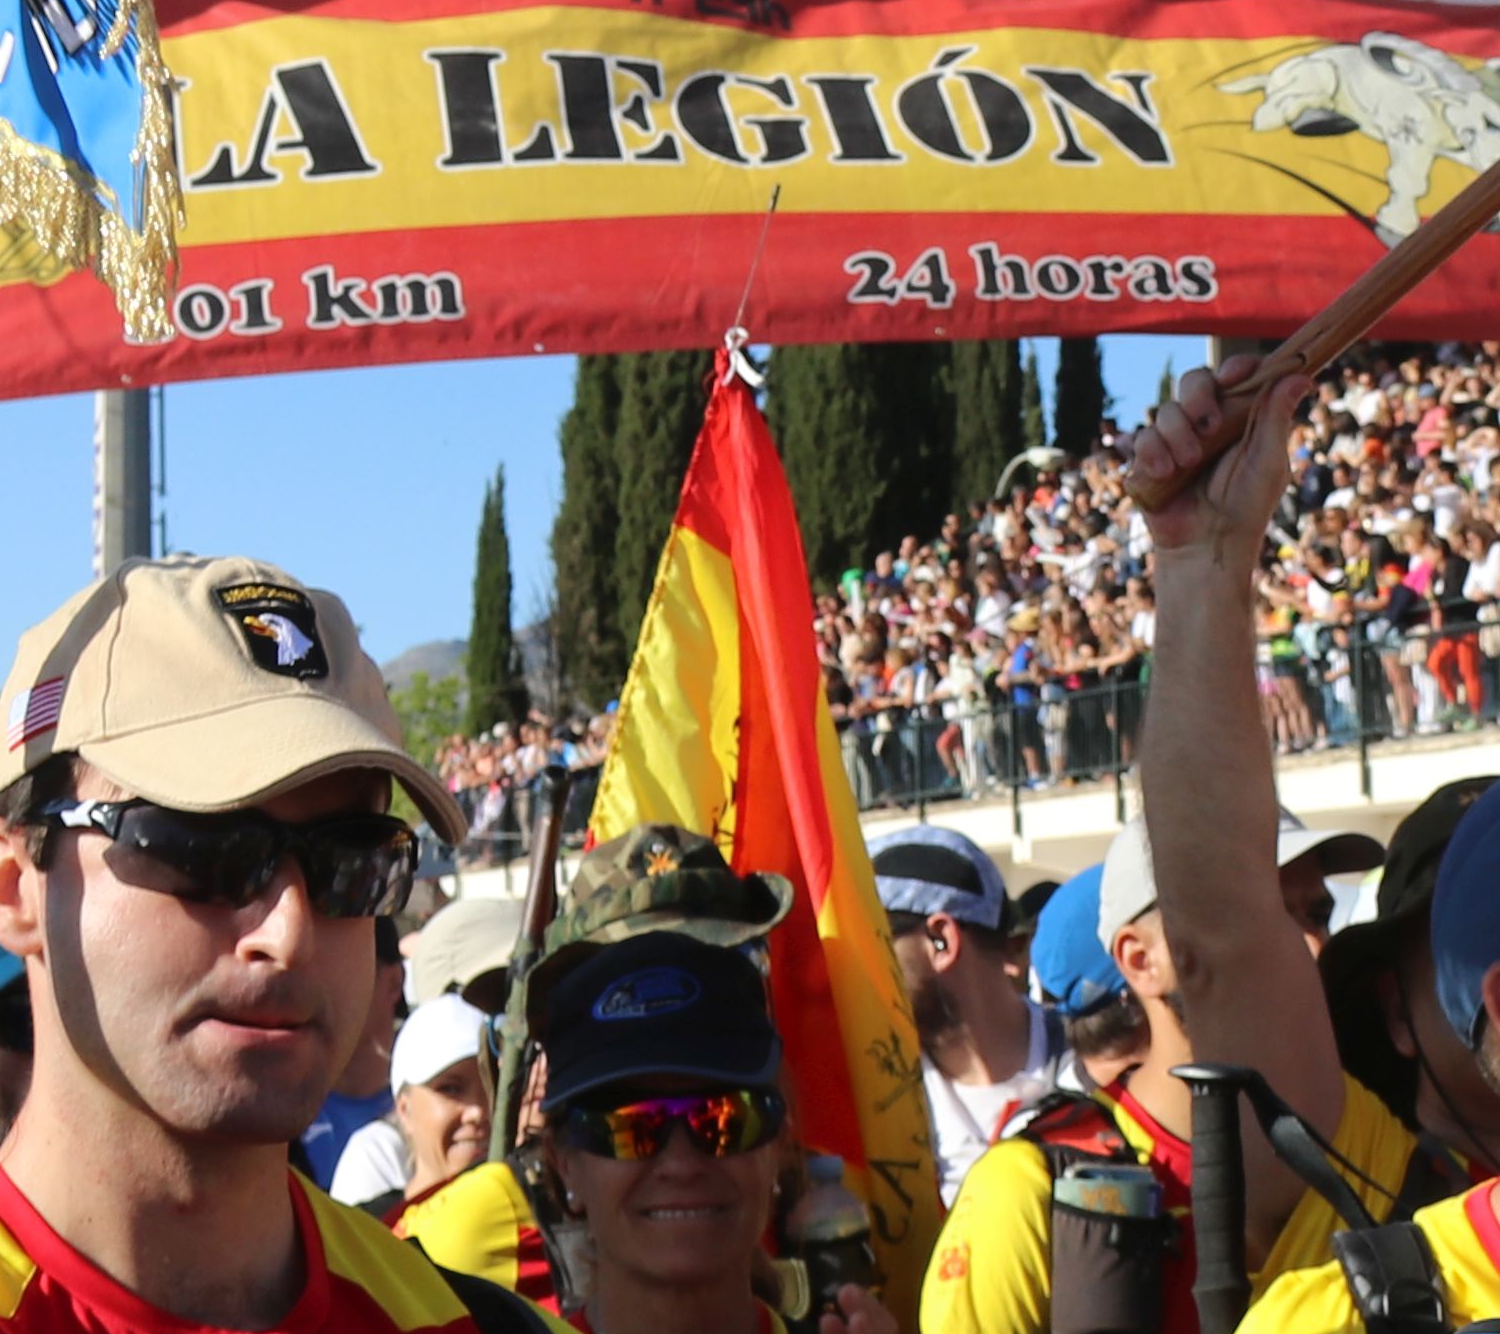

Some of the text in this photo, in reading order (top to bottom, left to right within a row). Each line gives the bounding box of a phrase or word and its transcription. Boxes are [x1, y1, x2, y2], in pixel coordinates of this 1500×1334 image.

[163, 43, 1176, 189] LA LEGIÓN
[172, 240, 1219, 341] 01 km 24 horas
